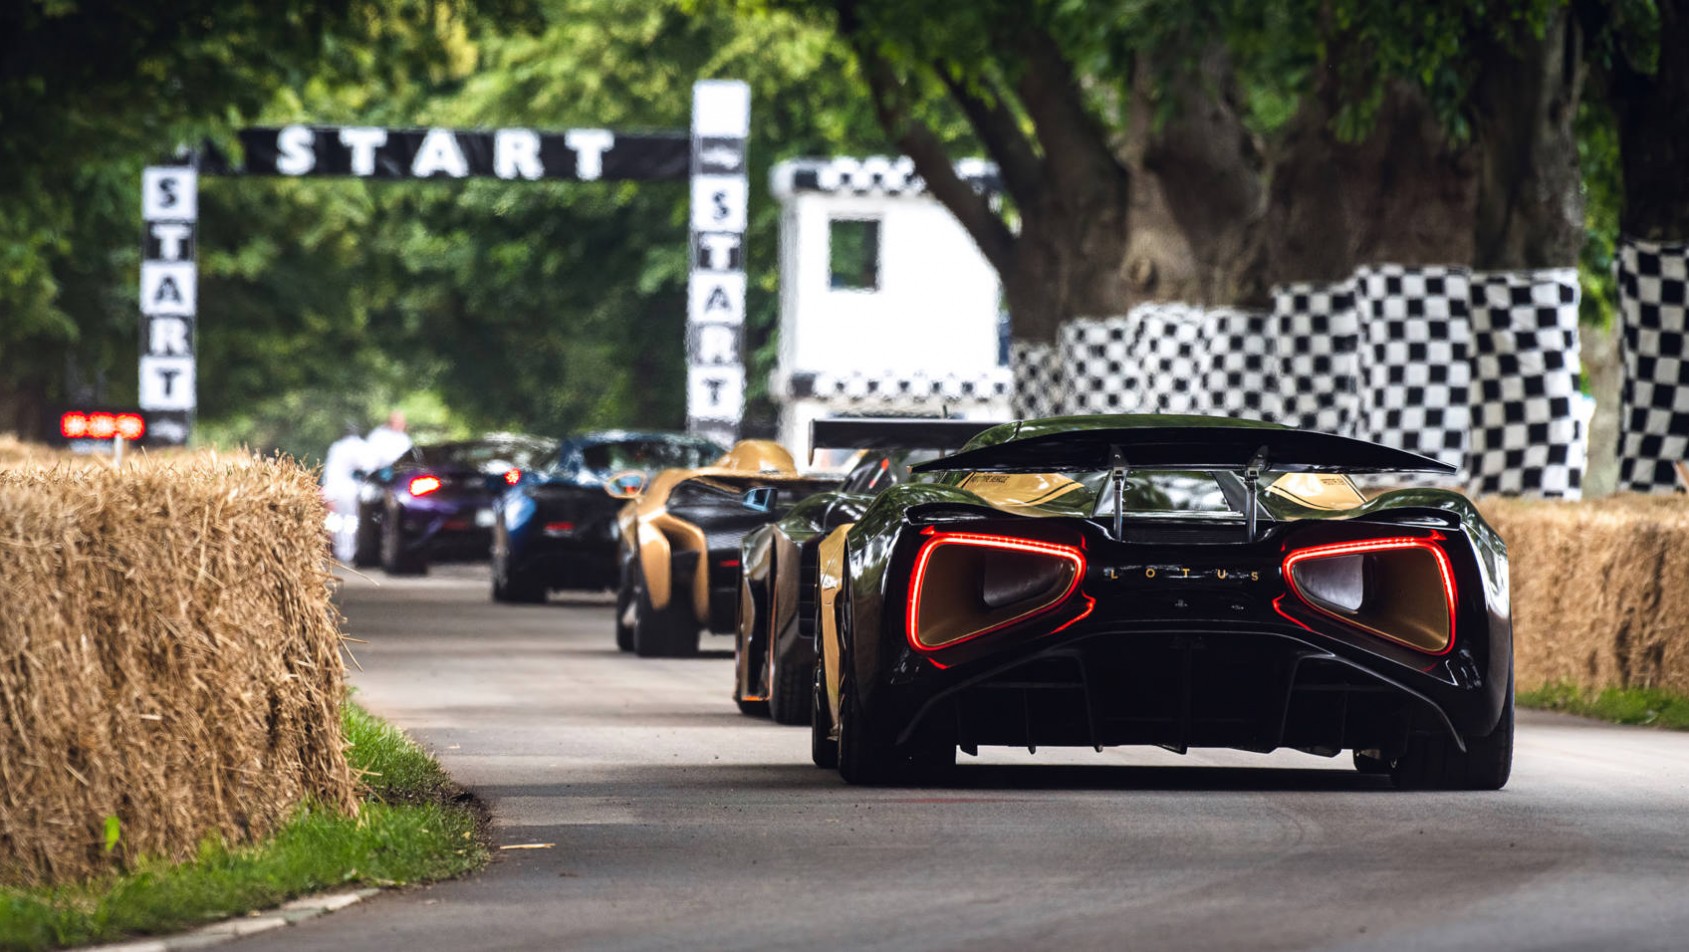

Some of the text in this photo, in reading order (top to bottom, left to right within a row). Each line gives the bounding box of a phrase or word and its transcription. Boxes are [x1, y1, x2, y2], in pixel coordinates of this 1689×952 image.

[276, 124, 615, 181] START
[151, 176, 191, 397] START
[700, 190, 741, 406] START
[1110, 567, 1259, 581] LOTUS
